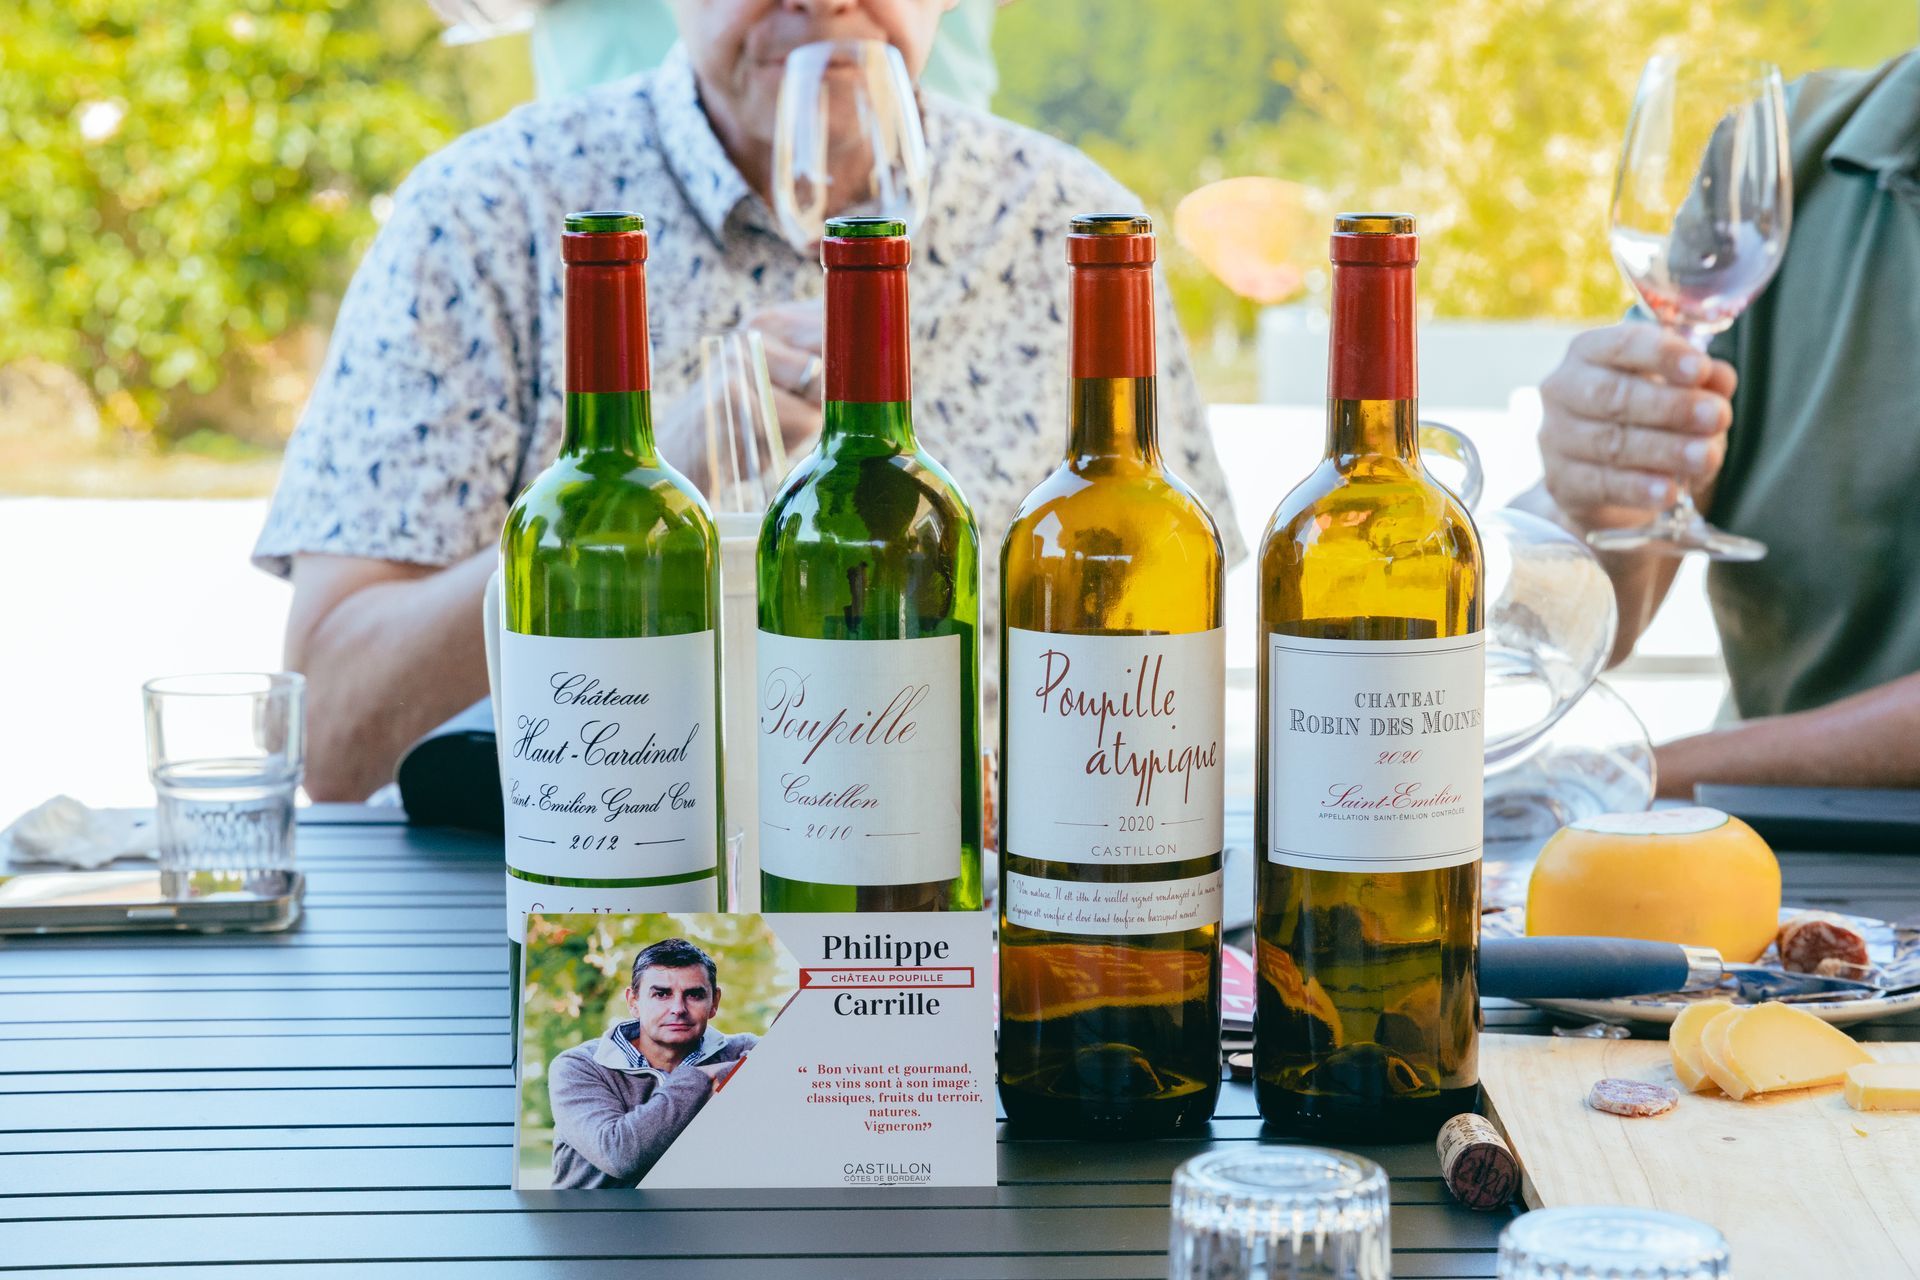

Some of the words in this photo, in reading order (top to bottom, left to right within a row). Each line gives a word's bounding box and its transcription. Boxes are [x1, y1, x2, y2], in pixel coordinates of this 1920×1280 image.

[550, 671, 650, 706] Château
[1035, 649, 1175, 748] Poupille
[1354, 690, 1446, 708] CHATEAU
[760, 666, 930, 765] Poupille
[1370, 717, 1414, 736] DES
[1374, 749, 1424, 765] 2020
[1085, 725, 1217, 807] atypique
[780, 772, 880, 809] Castillon
[1321, 782, 1463, 810] Saint-Emilion
[601, 787, 666, 822] Grand
[668, 782, 696, 809] Cru
[1119, 815, 1154, 832] 2020
[1319, 812, 1370, 821] APPELLATION
[806, 823, 853, 841] 2010
[569, 835, 619, 850] 2012
[1091, 844, 1176, 857] CASTILLON
[822, 934, 950, 967] Philippe
[831, 973, 885, 982] CHÂTEAU
[889, 974, 943, 982] POUPILLE
[834, 992, 941, 1016] Carrille
[817, 1064, 842, 1074] Bon
[846, 1063, 884, 1074] vivant
[887, 1065, 899, 1074] et
[903, 1063, 972, 1077] gourmand,
[811, 1080, 832, 1089] ses
[835, 1078, 861, 1089] vins
[864, 1079, 892, 1089] sont
[896, 1077, 903, 1089] à
[906, 1079, 929, 1088] son
[932, 1077, 970, 1090] image
[807, 1092, 876, 1105] classiques,
[878, 1092, 914, 1103] fruits
[918, 1092, 933, 1102] du
[937, 1092, 983, 1103] terroir,
[869, 1107, 921, 1117] natures.
[843, 1163, 931, 1175] CASTILLON
[844, 1174, 871, 1182] CÔTES
